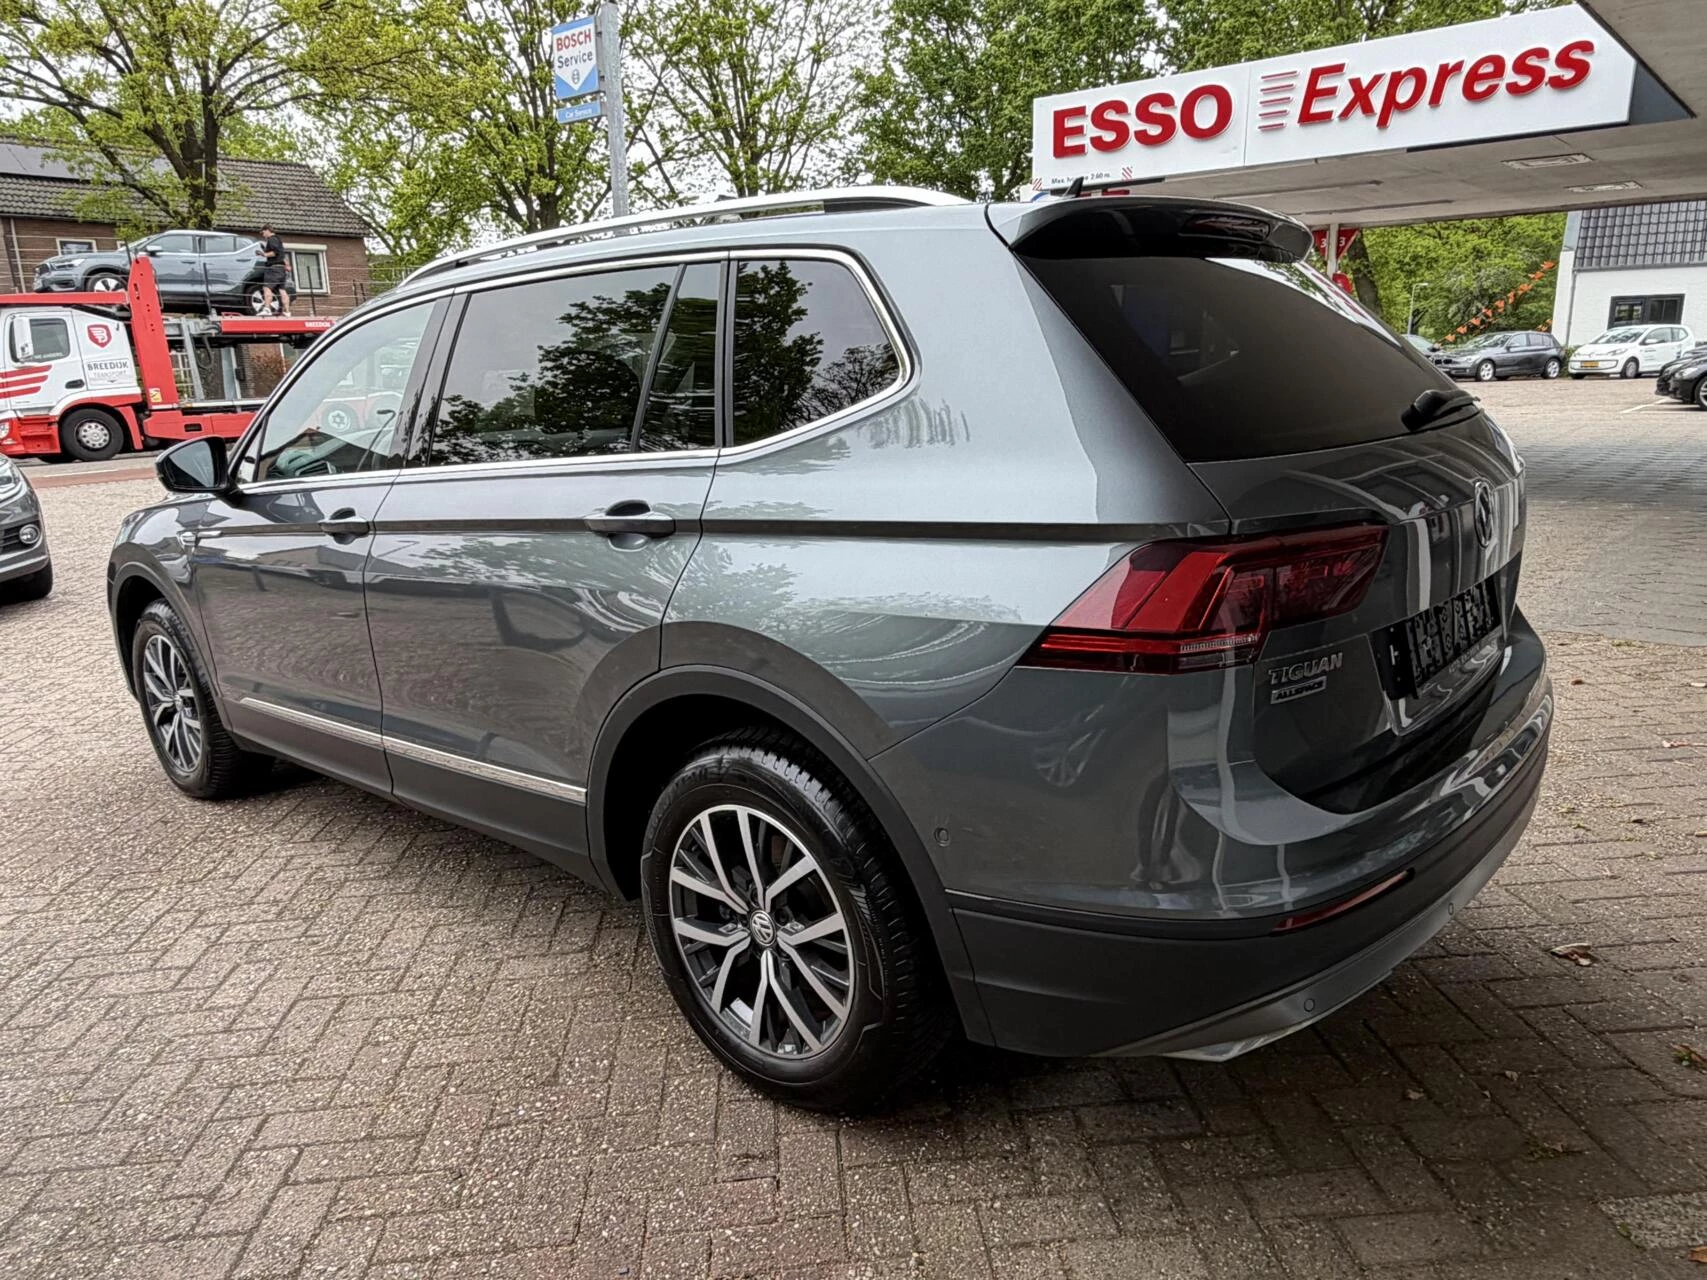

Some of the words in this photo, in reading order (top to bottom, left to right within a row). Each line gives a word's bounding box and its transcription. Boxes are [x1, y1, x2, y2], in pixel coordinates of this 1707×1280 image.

[556, 29, 592, 52] BOSCH
[557, 50, 593, 69] Service
[1053, 84, 1233, 158] ESSO
[1297, 40, 1595, 128] Express
[1320, 238, 1328, 248] 3
[1339, 236, 1346, 247] 3
[87, 361, 129, 371] BREEDIJK
[1268, 652, 1343, 685] TIGUAN
